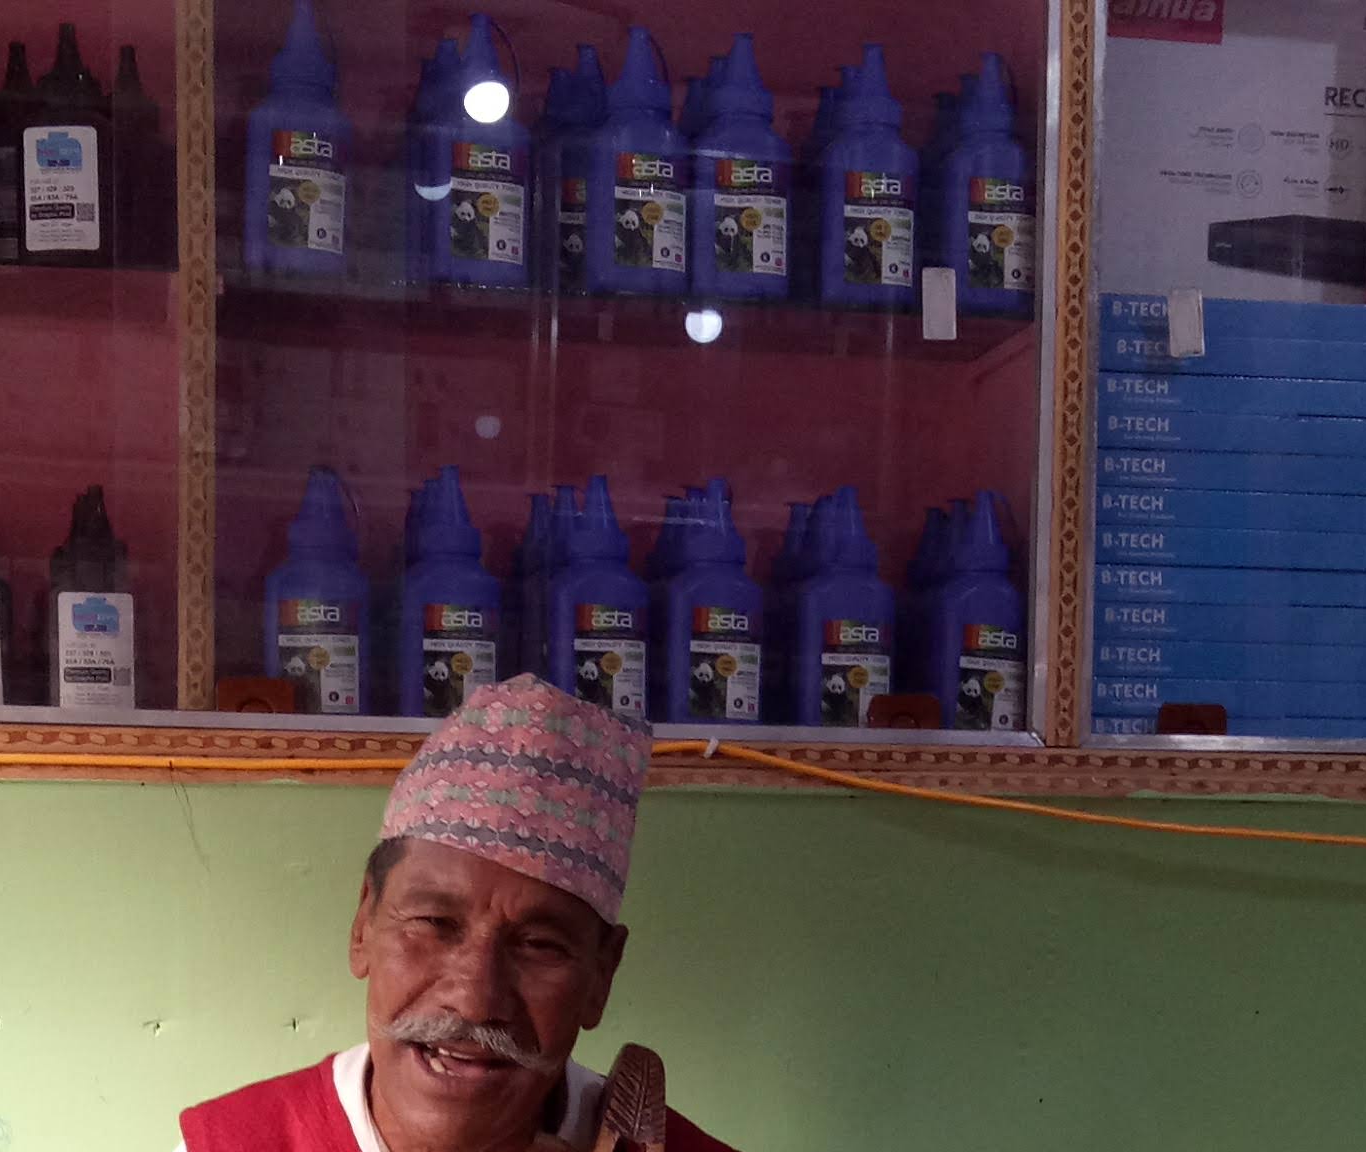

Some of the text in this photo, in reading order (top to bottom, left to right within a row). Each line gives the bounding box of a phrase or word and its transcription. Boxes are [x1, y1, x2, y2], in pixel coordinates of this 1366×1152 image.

[290, 137, 333, 158] asta
[468, 150, 510, 171] asta
[633, 160, 673, 178] asta
[731, 164, 772, 184] asta
[861, 174, 901, 195] asta
[983, 182, 1024, 201] asta
[1116, 340, 1168, 354] B-TEC
[1107, 379, 1168, 394] B-TECH
[1108, 416, 1169, 432] B-TECH
[1104, 458, 1166, 473] B-TECH
[1102, 495, 1163, 510] B-TECH
[1103, 533, 1164, 548] B-TECH
[1101, 571, 1162, 586] B-TECH
[297, 605, 340, 622] asta
[441, 610, 482, 627] asta
[591, 610, 632, 628] asta
[708, 612, 749, 631] asta
[1105, 608, 1166, 624] B-TECH
[840, 624, 879, 642] asta
[978, 629, 1017, 649] asta
[1100, 647, 1161, 662] B-TECH
[1097, 683, 1157, 699] B-TECH
